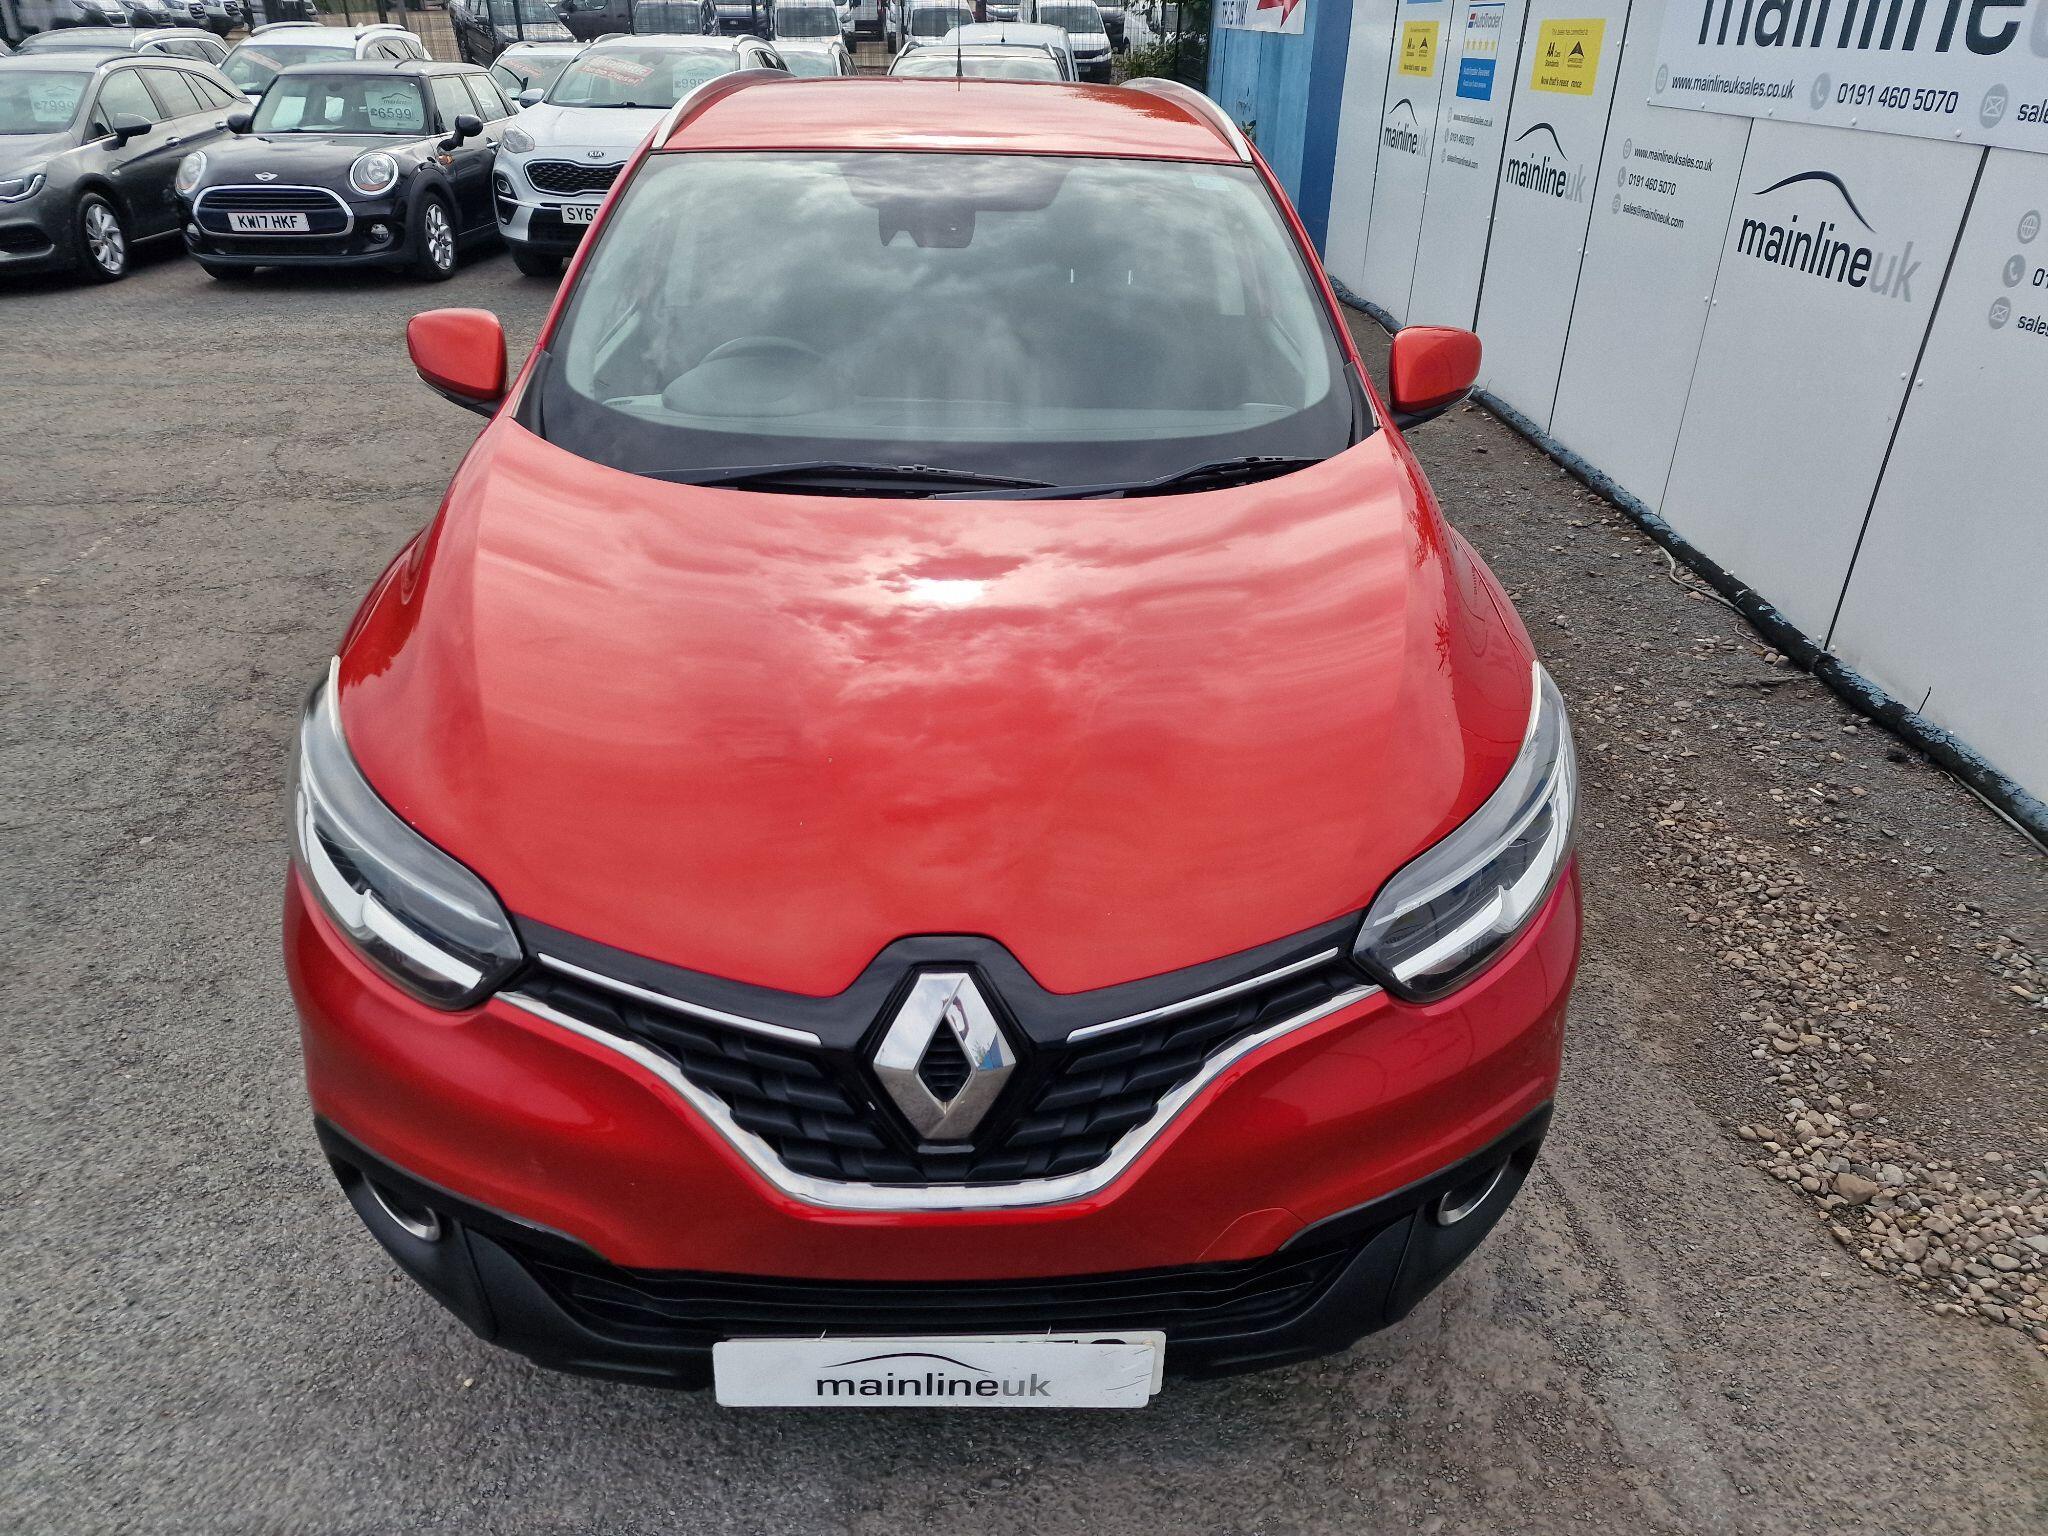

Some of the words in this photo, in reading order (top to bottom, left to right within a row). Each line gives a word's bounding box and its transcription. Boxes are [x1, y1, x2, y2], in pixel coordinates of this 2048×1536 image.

[1671, 71, 1795, 100] www.mainlineuksales.co.uk
[1837, 82, 1874, 106] 0191
[1878, 86, 1911, 109] 460
[1913, 89, 1959, 114] 5070
[1383, 122, 1428, 158] mainlineuk
[1634, 148, 1713, 172] www.mainlineuksales.co.uk
[1506, 153, 1586, 203] mainlineuk
[1628, 173, 1644, 188] 0191
[1645, 177, 1658, 191] 460
[1658, 180, 1677, 196] 5070
[237, 215, 268, 229] KW17
[271, 215, 298, 229] HKF
[1622, 202, 1685, 229] sales@mainlineuk.com
[1736, 214, 1922, 302] mainlineuk
[816, 1372, 1052, 1398] mainlineuk
